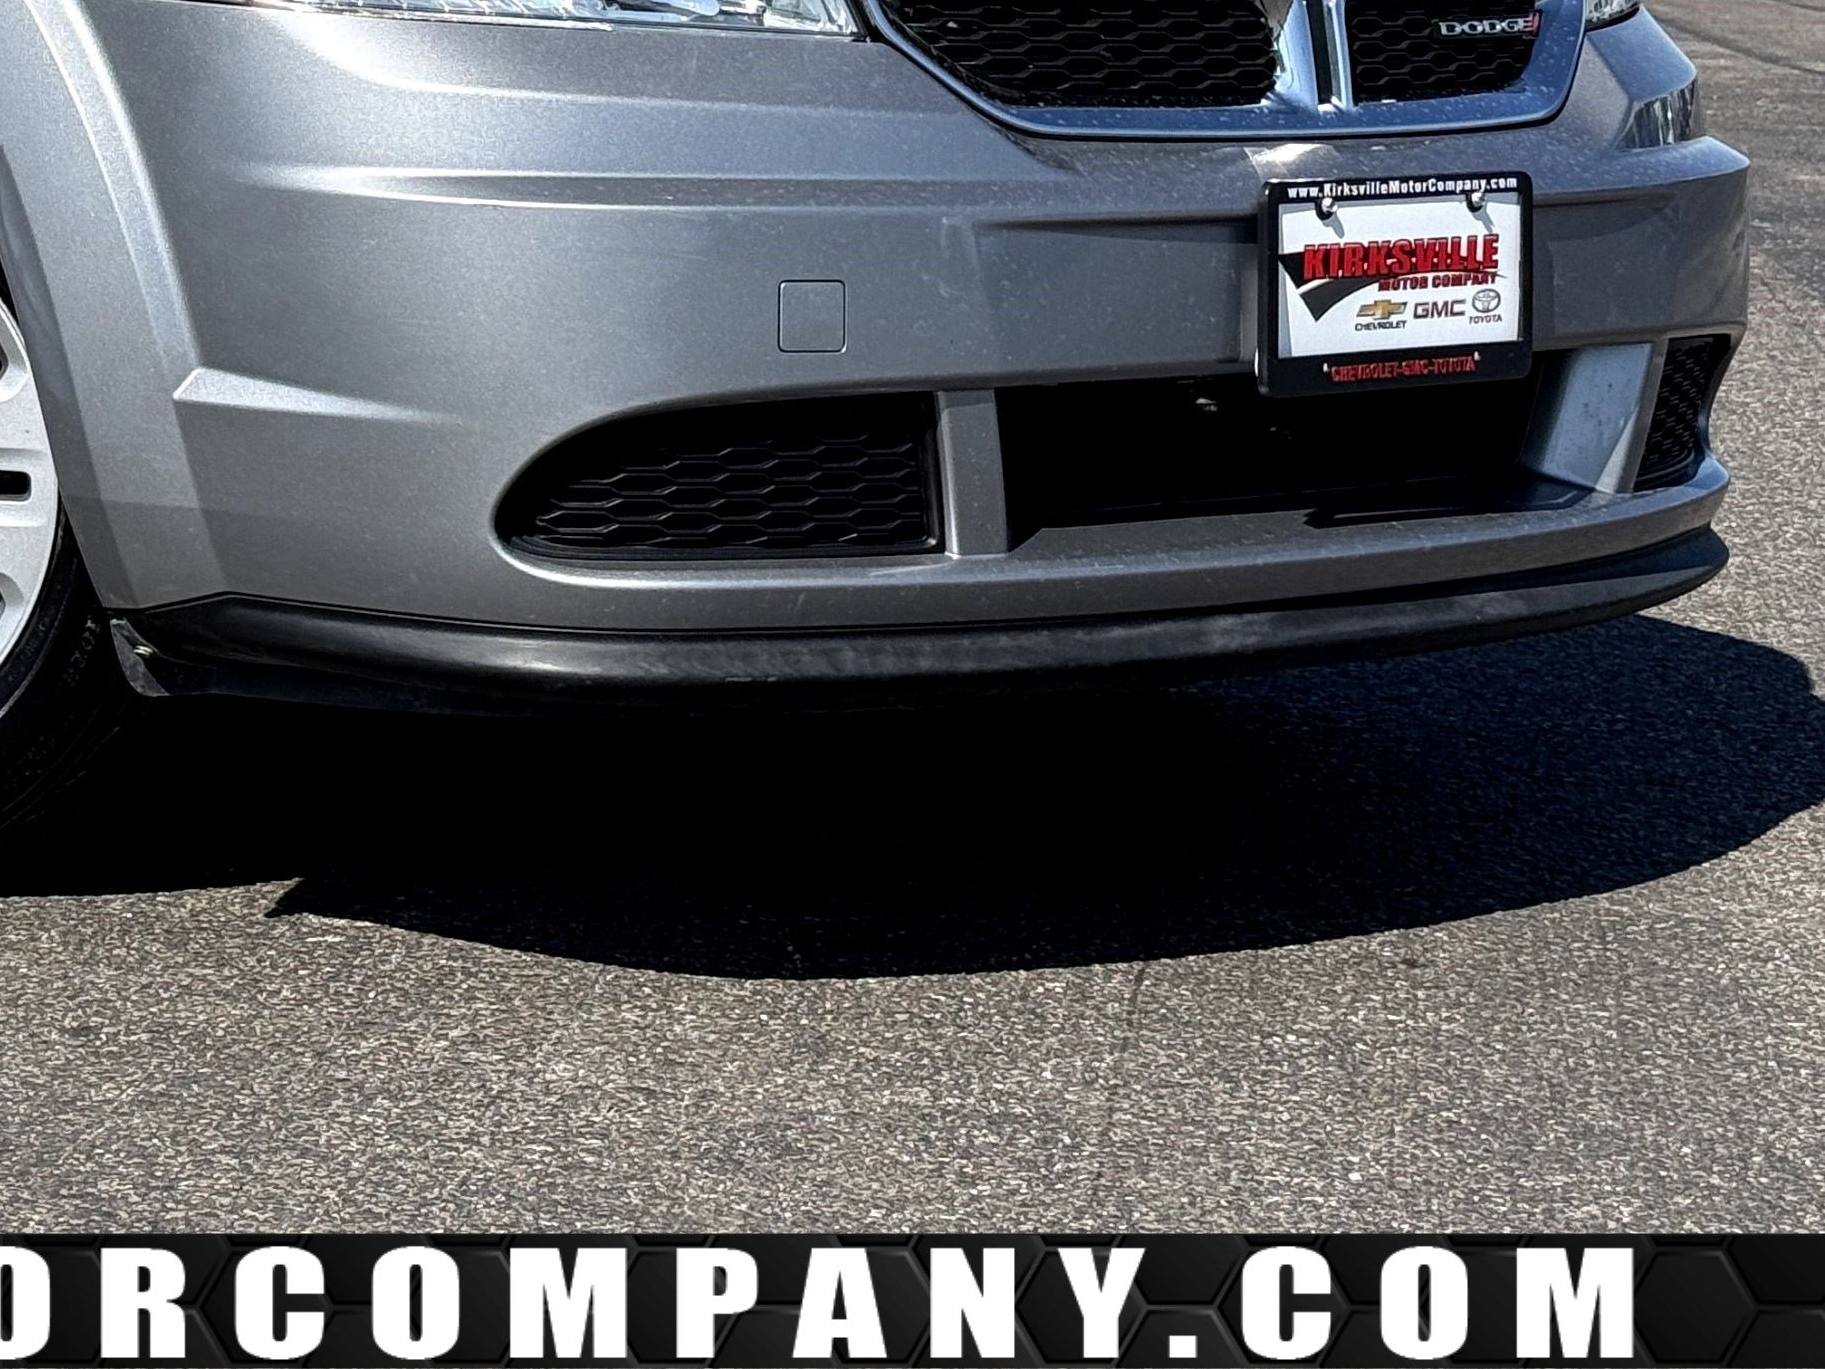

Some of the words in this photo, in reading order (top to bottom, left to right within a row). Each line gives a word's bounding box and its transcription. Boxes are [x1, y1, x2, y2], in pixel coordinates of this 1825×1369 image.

[1438, 13, 1535, 36] DODGE
[1287, 177, 1518, 199] www.KirksvilleMotorCompany.com
[1303, 234, 1500, 281] KIRKSVILLE
[1377, 275, 1430, 292] MOTOR
[1431, 271, 1497, 290] COMPANY
[1412, 298, 1467, 319] GMC
[1468, 314, 1503, 324] TOYOTA
[1354, 319, 1408, 332] CHEVROLET
